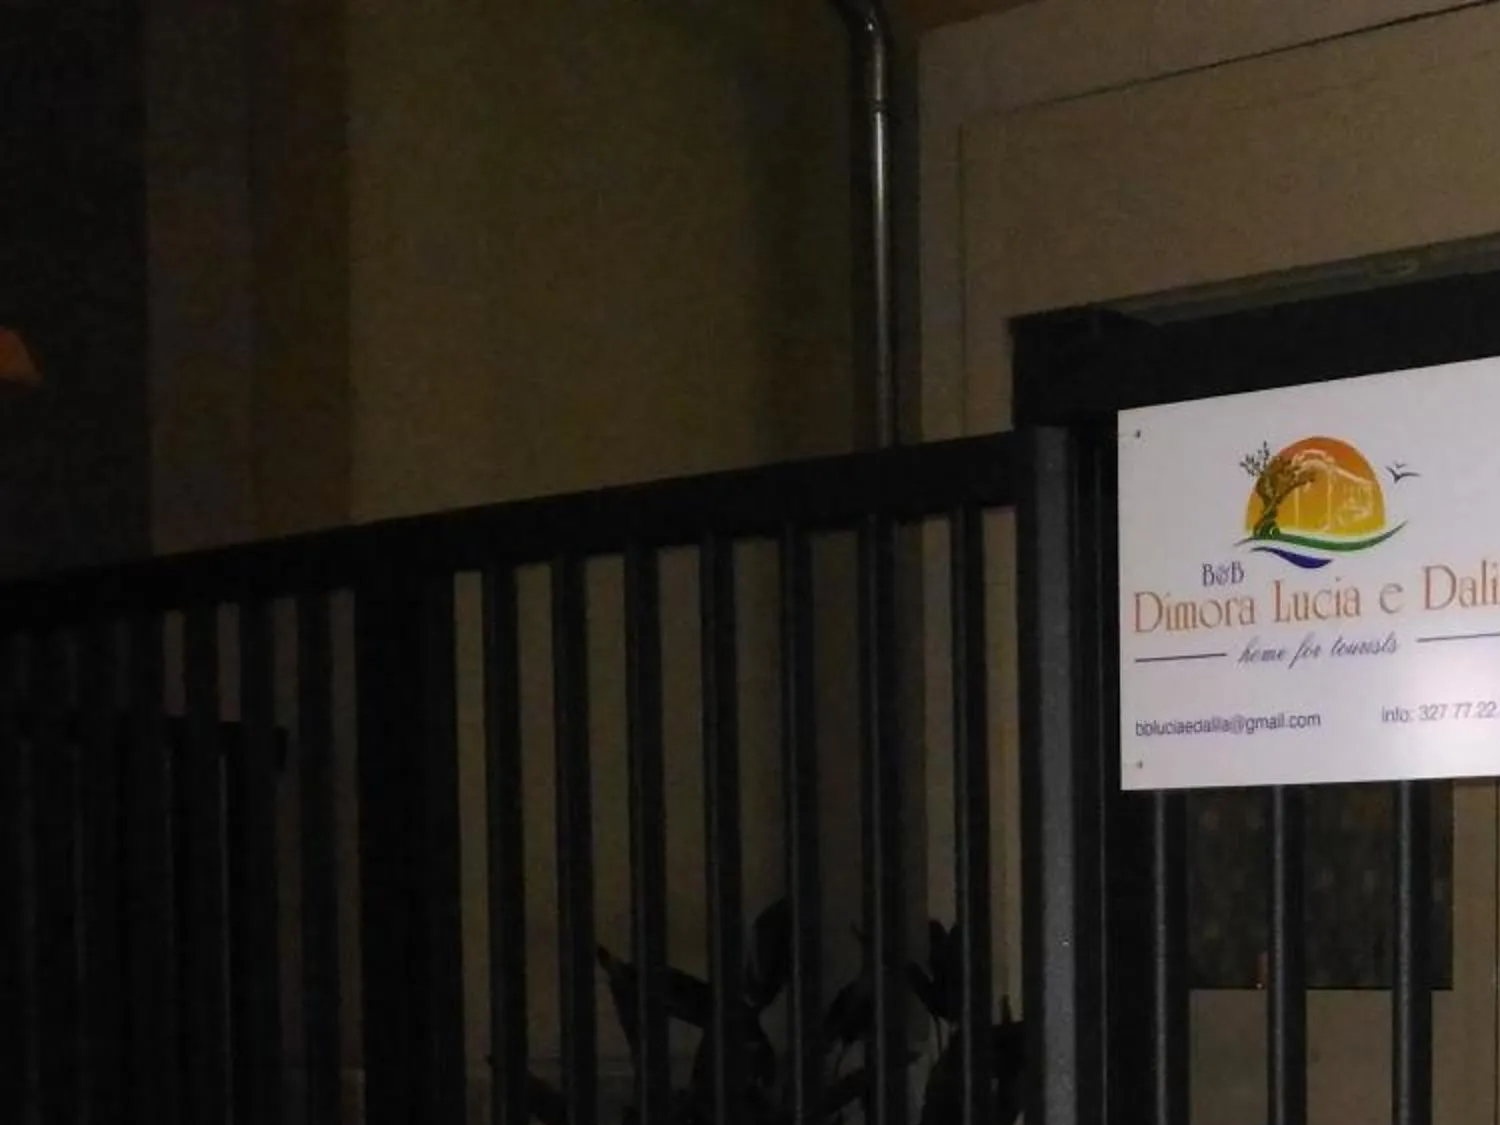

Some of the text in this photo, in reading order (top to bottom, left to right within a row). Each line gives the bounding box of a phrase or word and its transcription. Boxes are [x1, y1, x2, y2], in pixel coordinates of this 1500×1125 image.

[1202, 561, 1245, 587] B&B
[1134, 590, 1256, 633] Dimora
[1273, 576, 1361, 623] Lucia
[1379, 582, 1404, 614] e
[1239, 630, 1398, 669] home for tourists
[1418, 703, 1448, 721] 327
